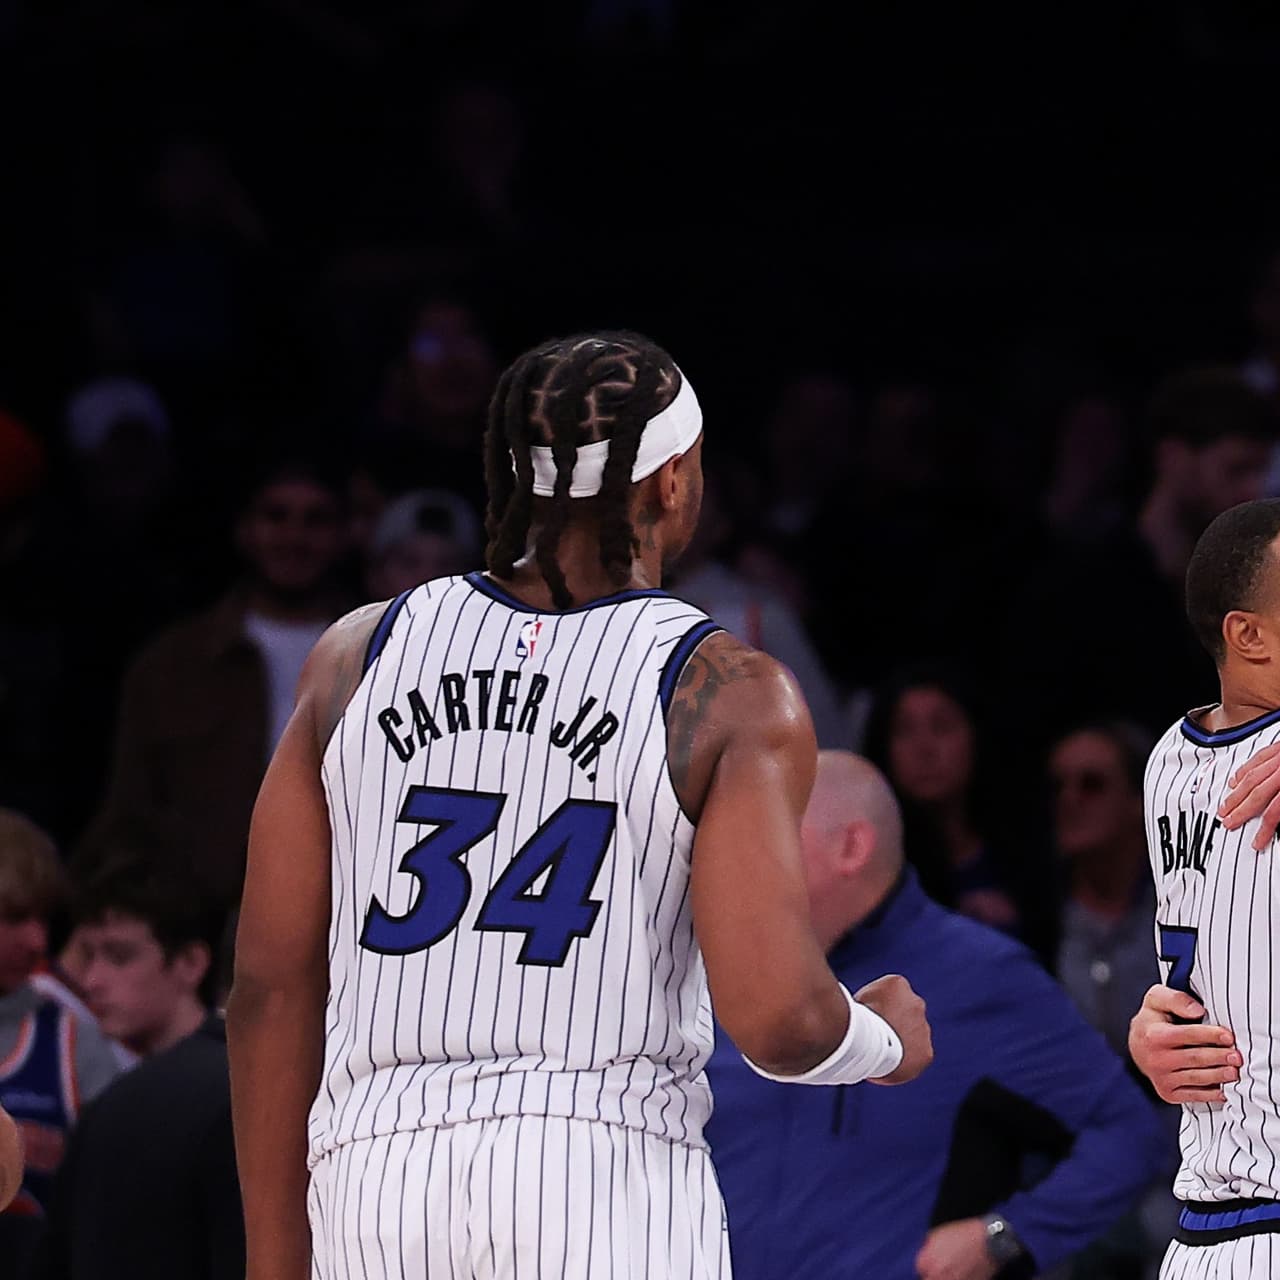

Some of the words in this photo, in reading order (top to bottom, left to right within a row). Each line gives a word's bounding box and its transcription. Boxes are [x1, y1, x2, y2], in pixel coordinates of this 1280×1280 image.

[378, 669, 550, 763] CARTER
[551, 696, 619, 783] JR.
[358, 784, 618, 967] 34
